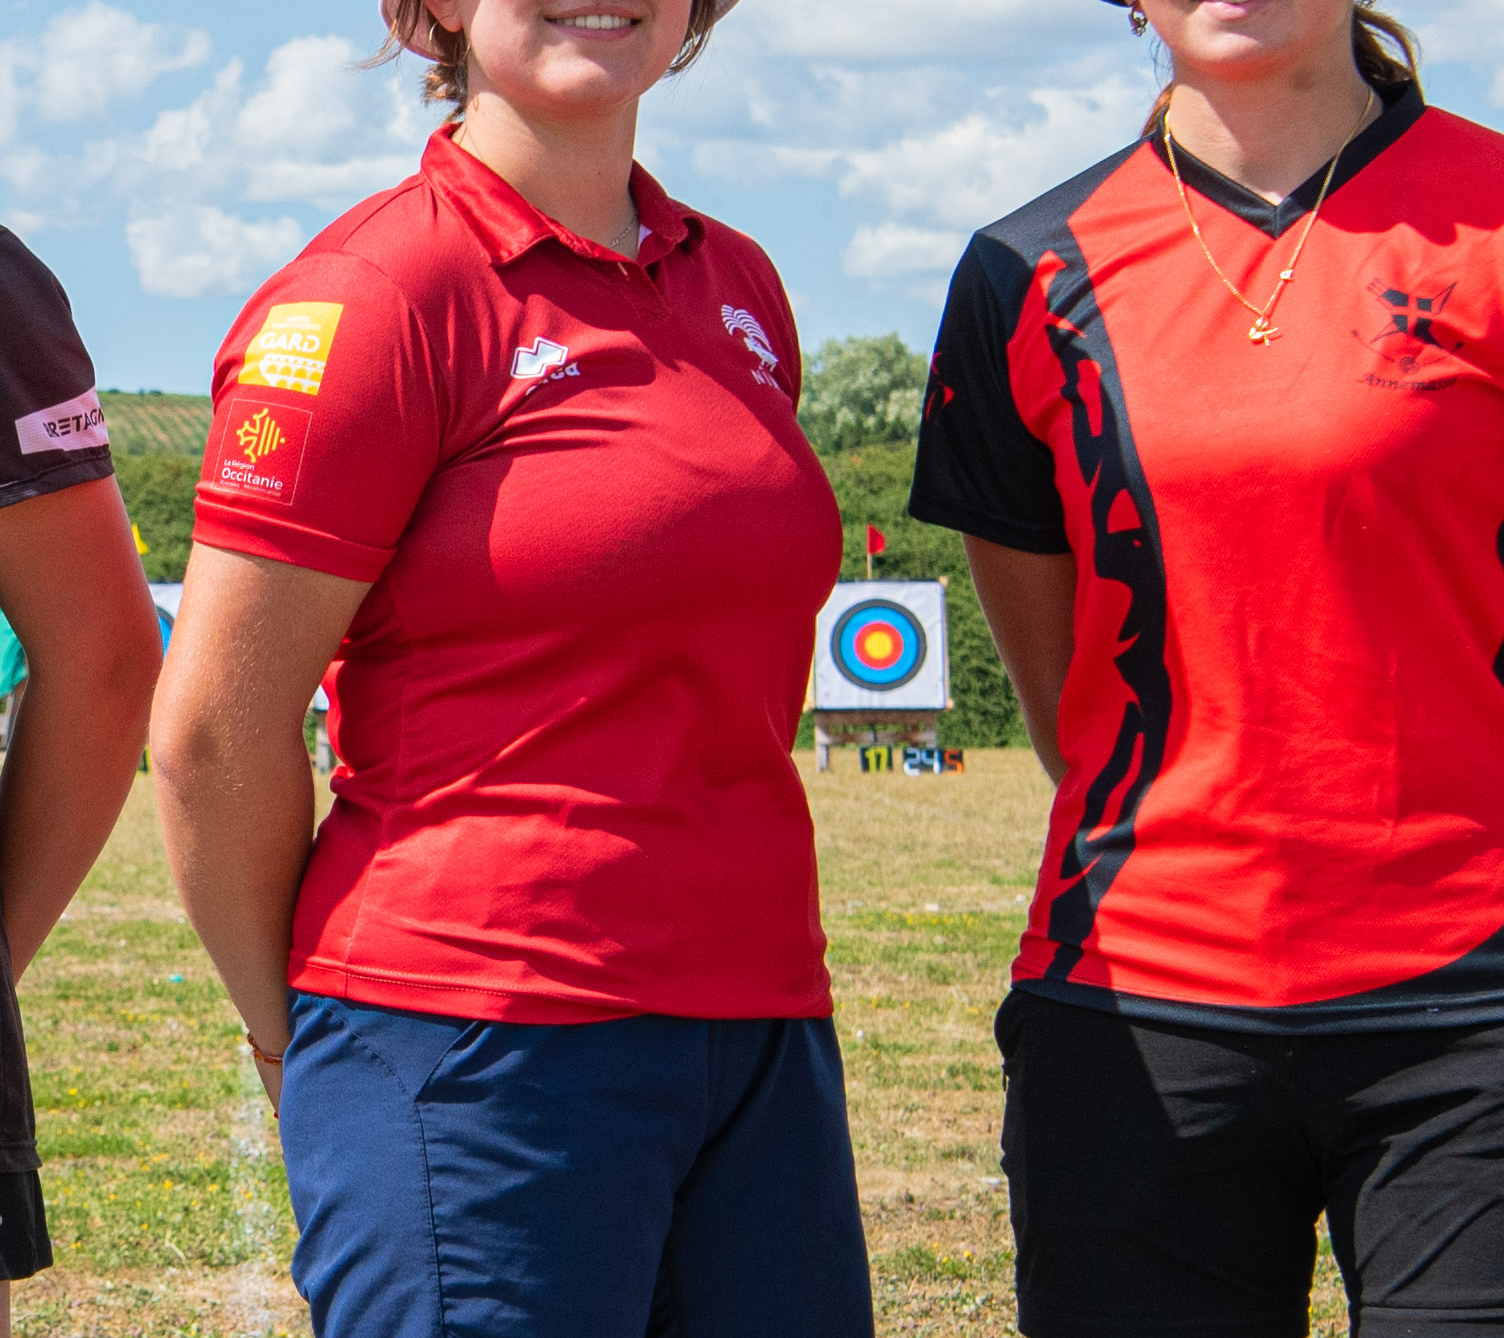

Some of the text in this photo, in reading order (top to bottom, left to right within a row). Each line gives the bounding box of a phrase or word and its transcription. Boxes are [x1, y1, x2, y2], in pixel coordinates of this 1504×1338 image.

[259, 332, 320, 353] GARD
[222, 467, 284, 490] Occitanie
[864, 746, 889, 774] 17
